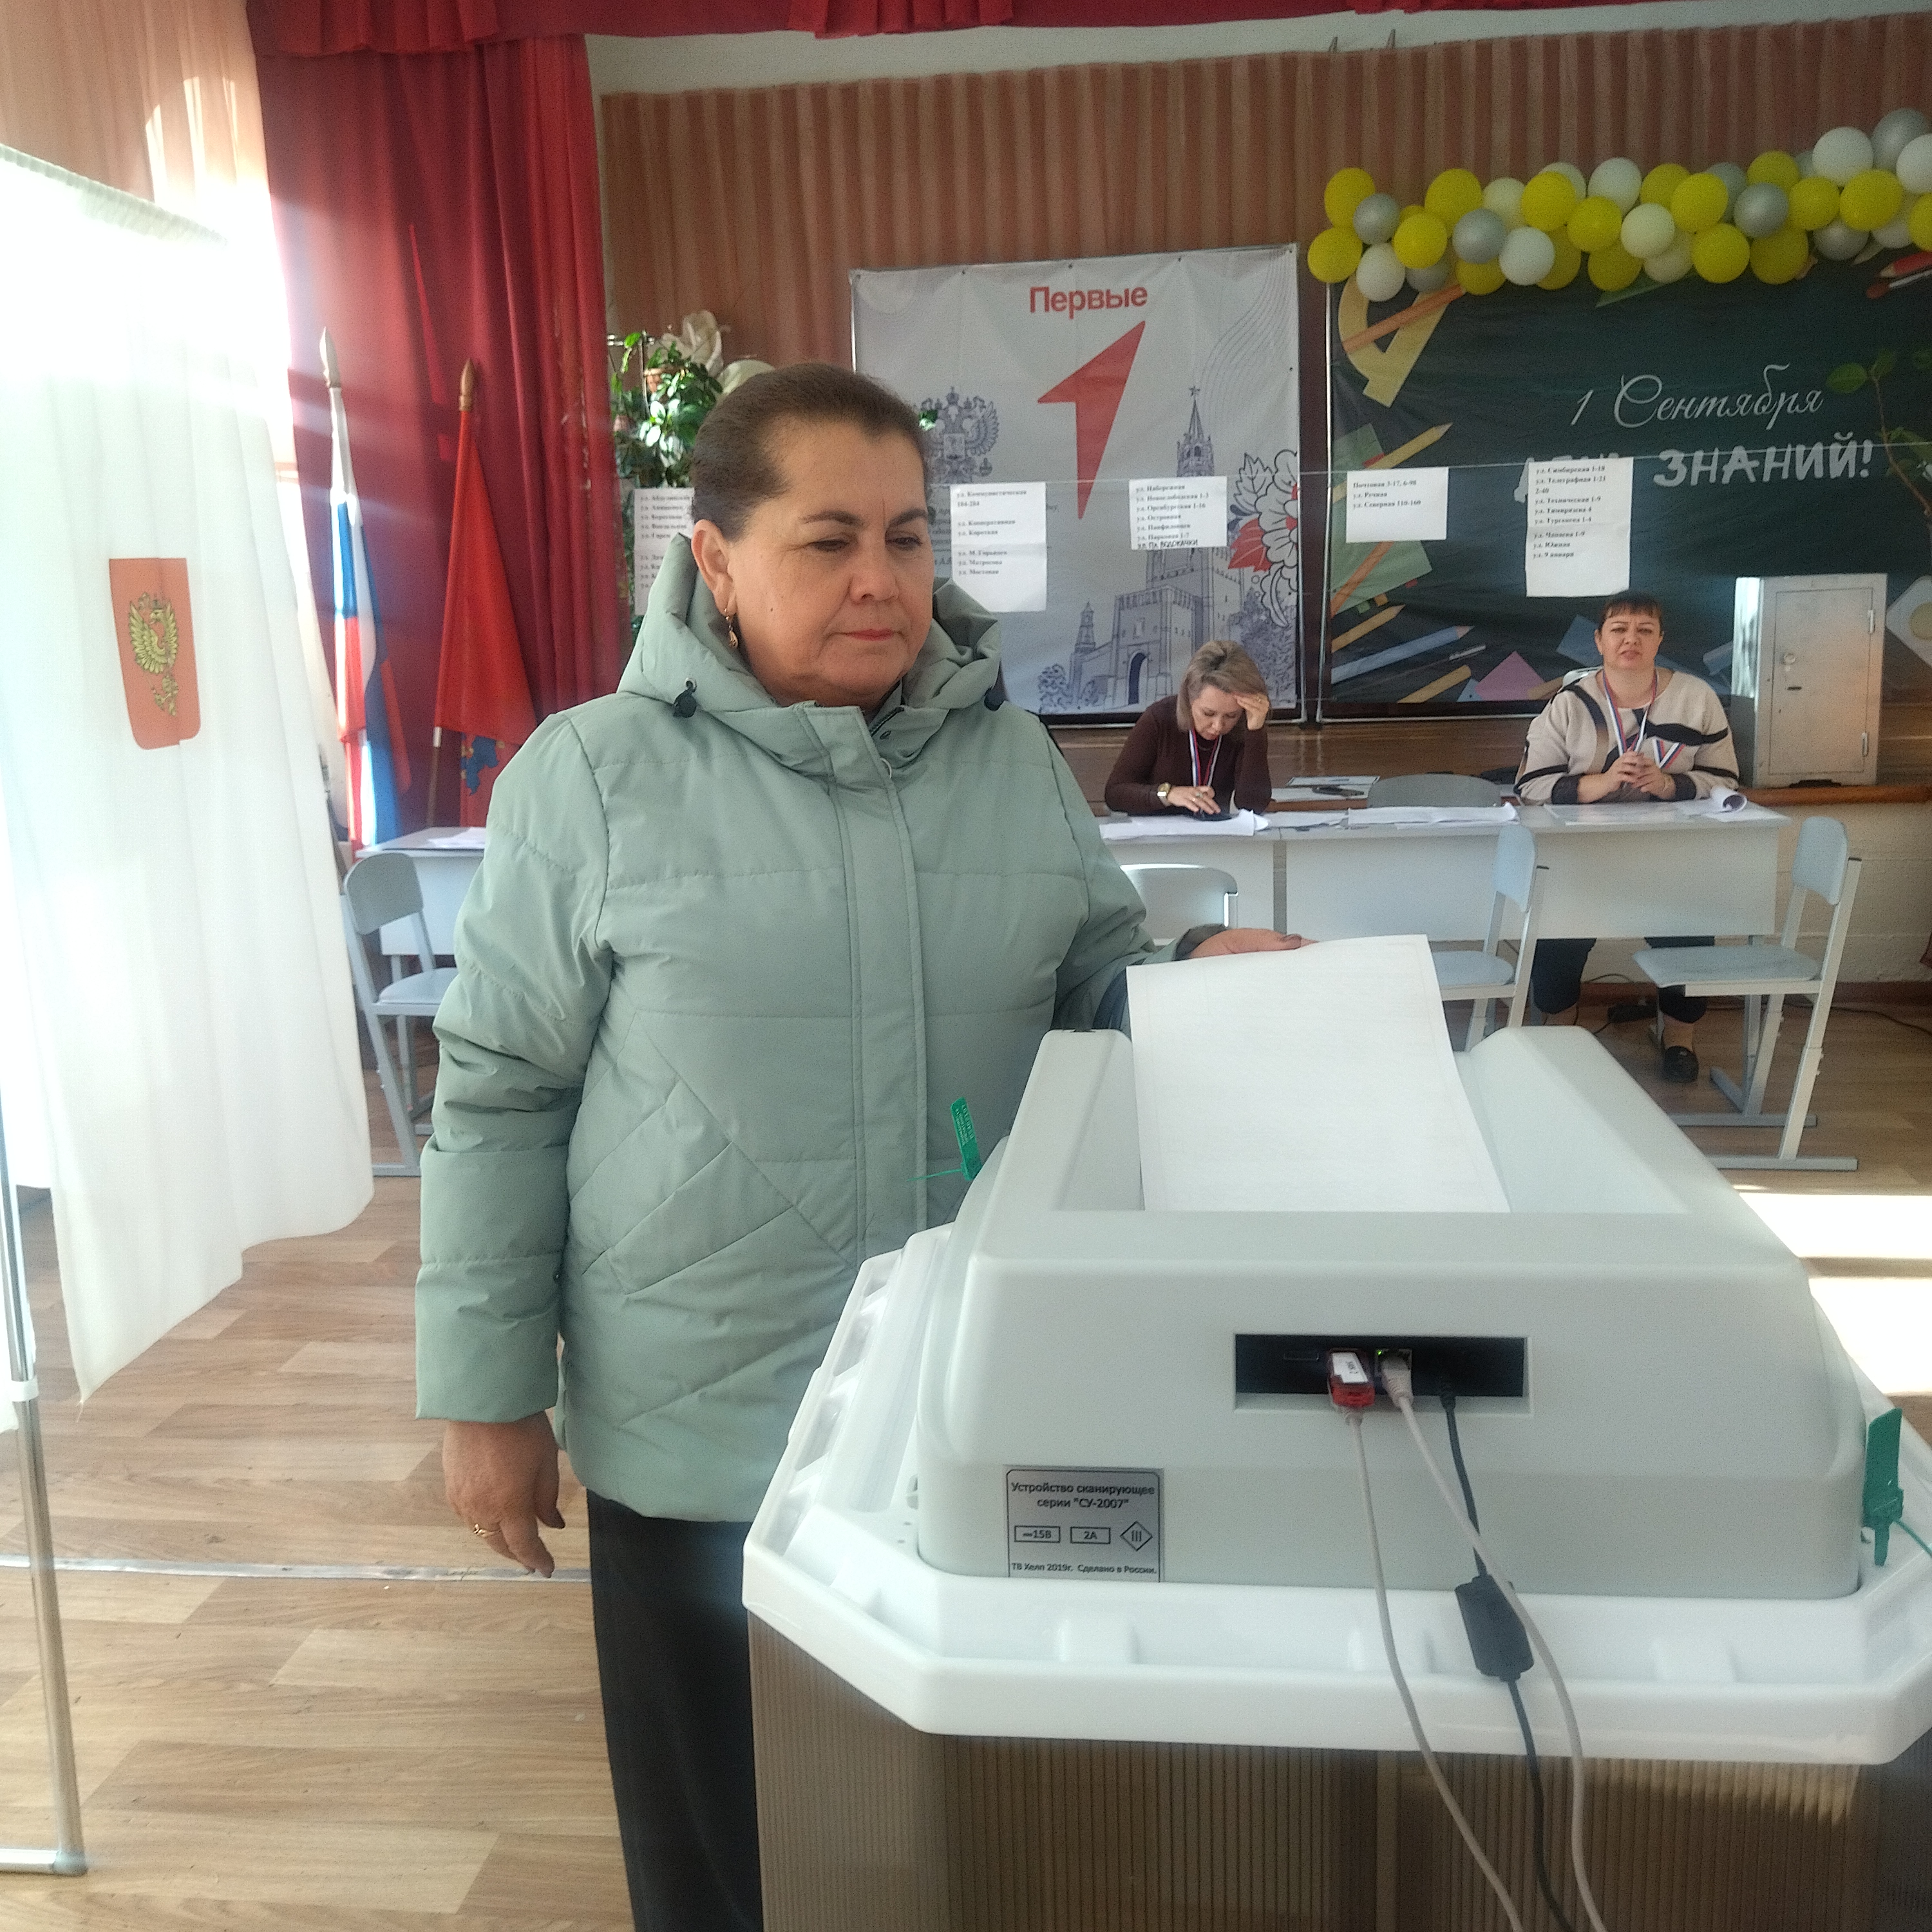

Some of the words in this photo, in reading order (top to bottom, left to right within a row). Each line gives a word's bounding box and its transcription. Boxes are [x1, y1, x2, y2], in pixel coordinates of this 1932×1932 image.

[1030, 286, 1148, 319] Первые
[1571, 390, 1594, 426] 1
[1613, 363, 1824, 430] Сентября
[1653, 431, 1875, 488] ЗНАНИЙ!
[1548, 476, 1591, 484] Телеграфная
[1011, 1482, 1074, 1493] Устройство
[1077, 1484, 1155, 1495] сканирующее
[1037, 1499, 1070, 1509] серии
[1074, 1498, 1130, 1508] "СУ-2007"
[1083, 1531, 1098, 1540] 2А
[1024, 1563, 1045, 1571] Хелп
[1047, 1564, 1074, 1572] 2019г.
[1077, 1564, 1114, 1573] Сделано
[1124, 1566, 1157, 1574] России.
